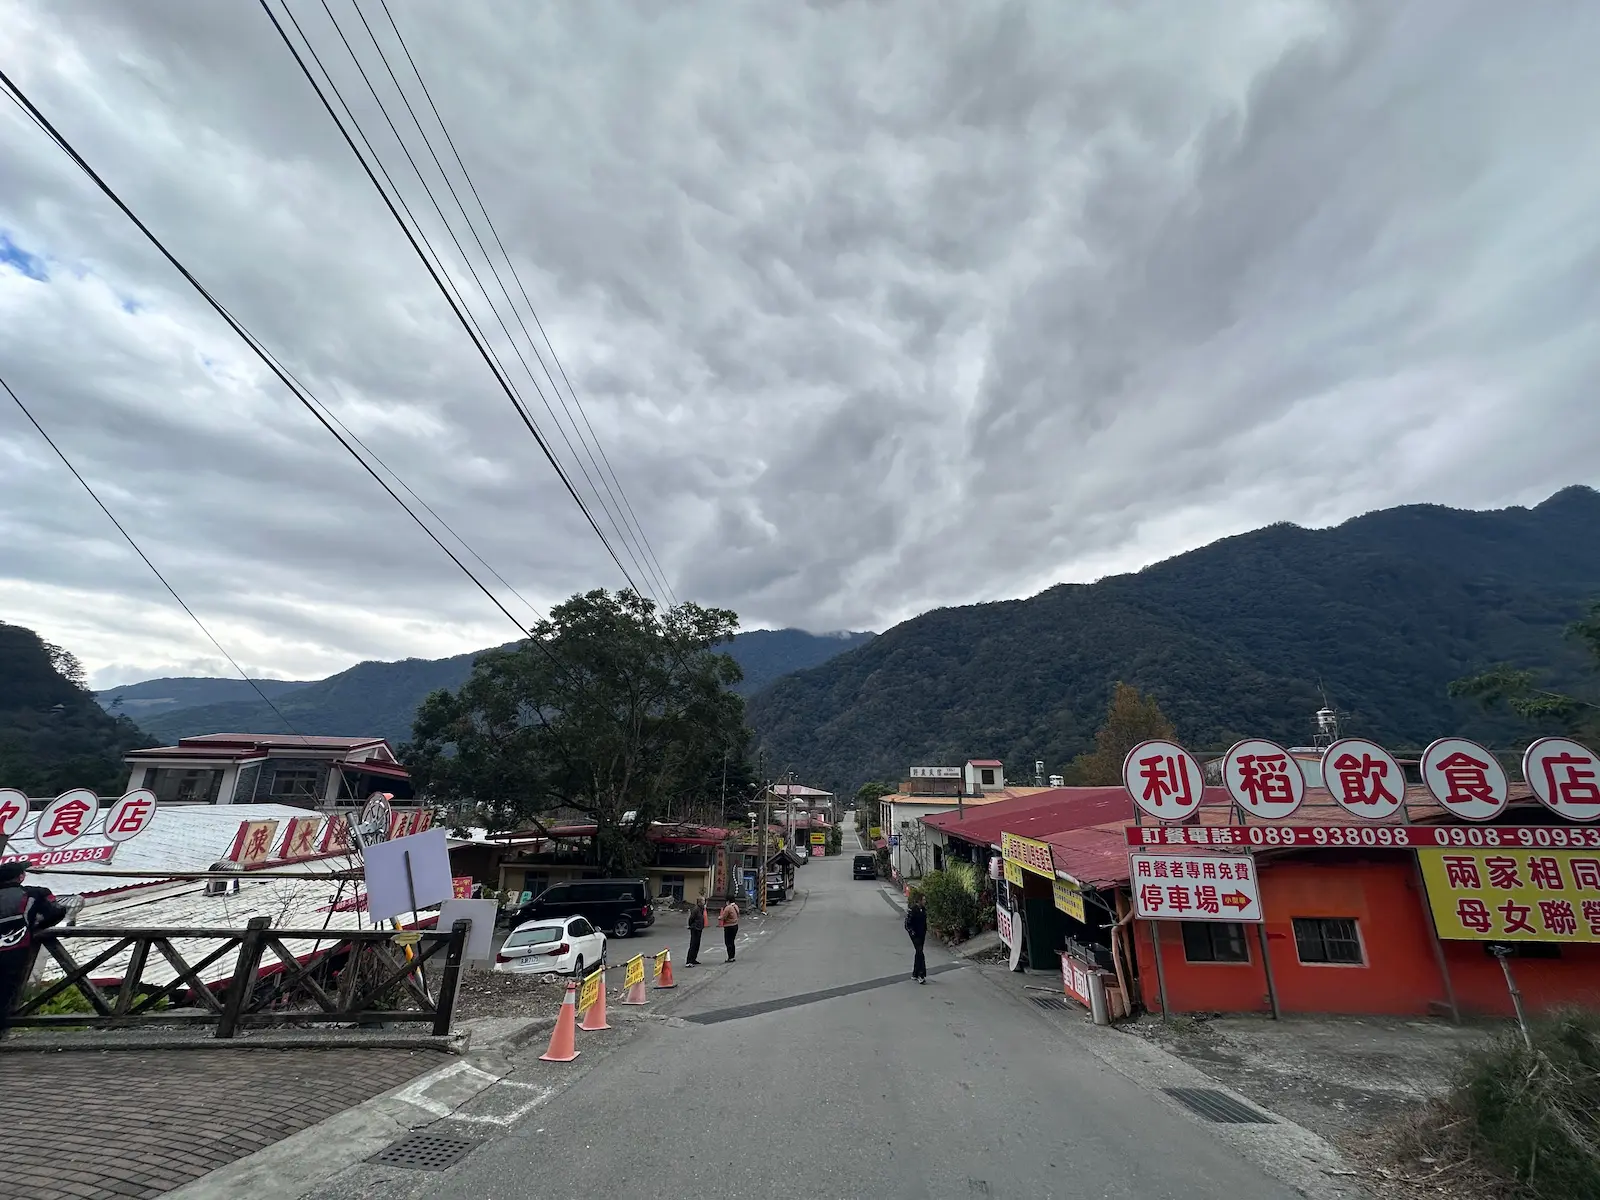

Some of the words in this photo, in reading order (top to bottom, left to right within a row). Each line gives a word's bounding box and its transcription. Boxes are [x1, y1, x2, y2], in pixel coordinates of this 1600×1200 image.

[1248, 827, 1410, 847] 089-938098
[1137, 860, 1250, 881] 用餐者專用免費
[1139, 883, 1220, 914] 停車場
